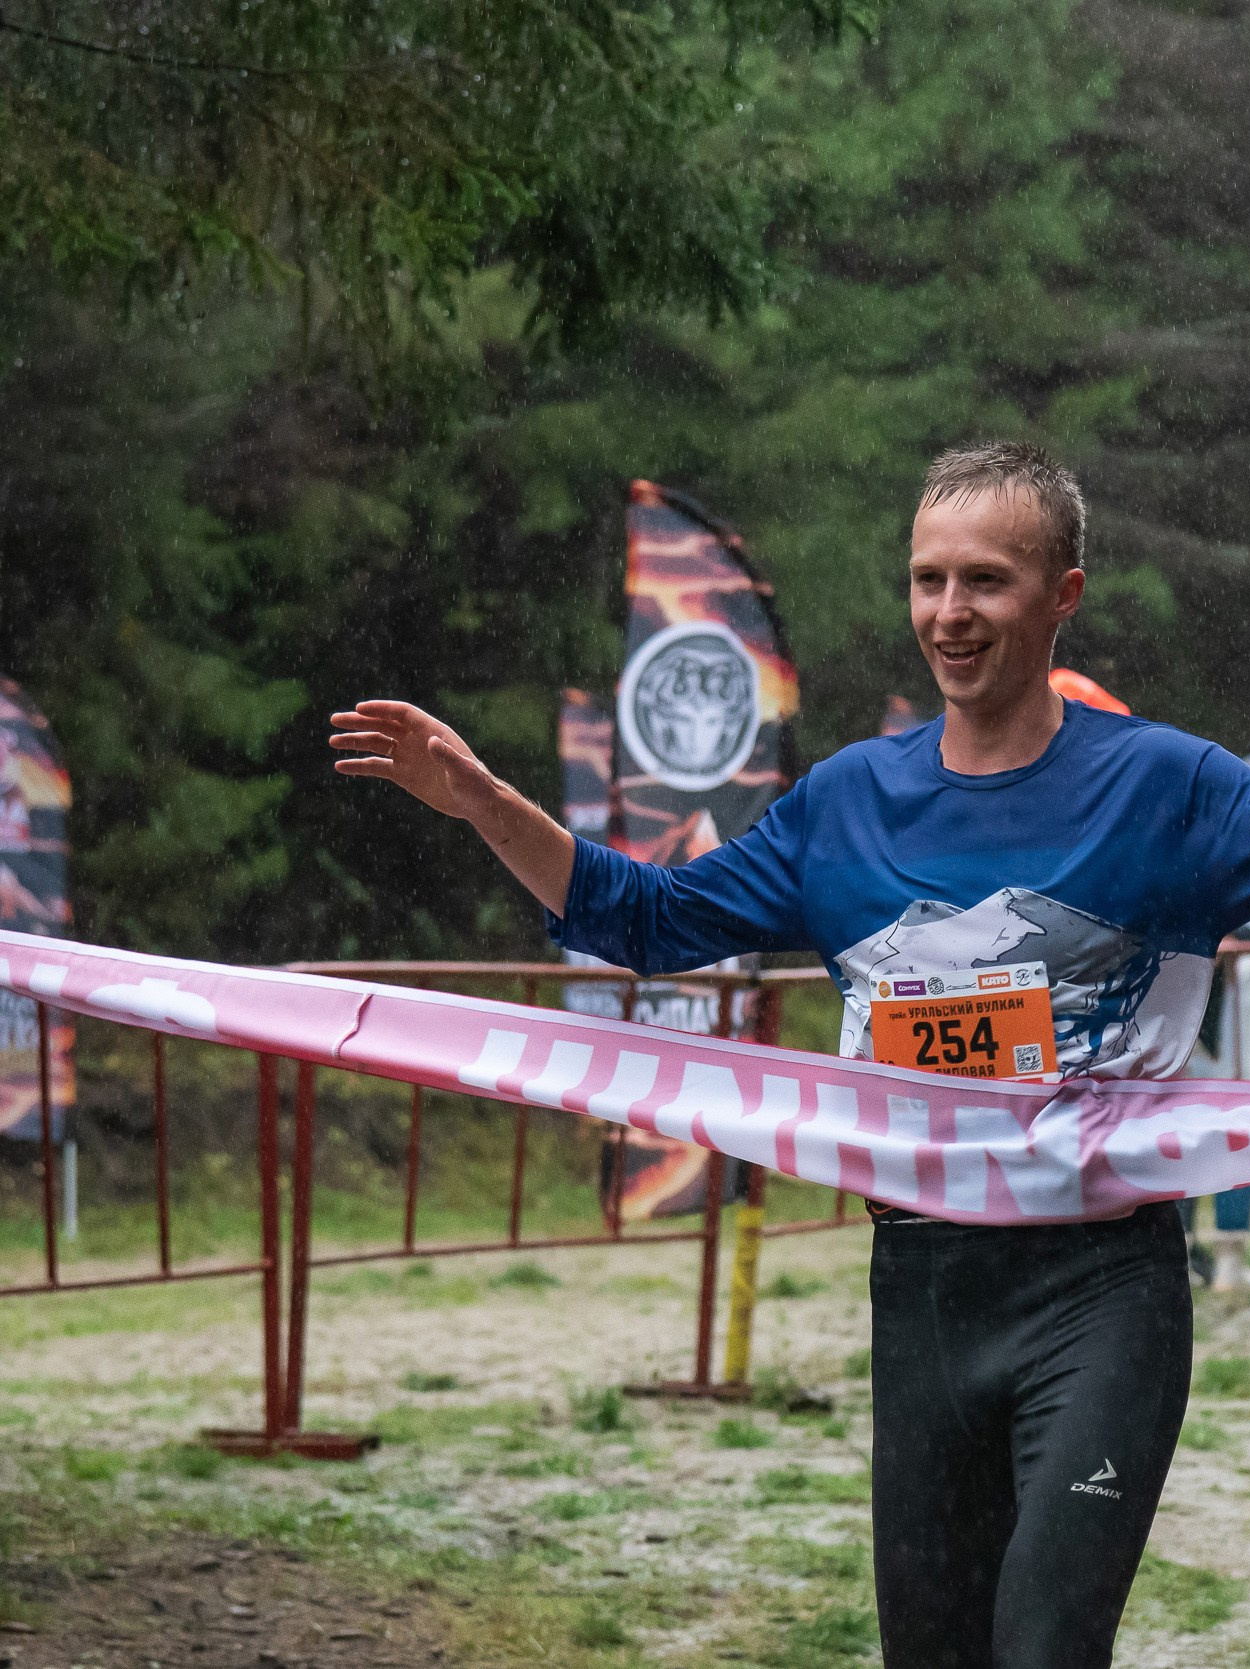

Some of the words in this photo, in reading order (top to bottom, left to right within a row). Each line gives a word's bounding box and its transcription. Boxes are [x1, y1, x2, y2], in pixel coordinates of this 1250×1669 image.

[908, 1000, 973, 1019] УРАЛЬСКИЙ
[976, 997, 1025, 1014] ВУЛКАН
[912, 1016, 999, 1066] 254
[1070, 1482, 1123, 1500] DEMIX
